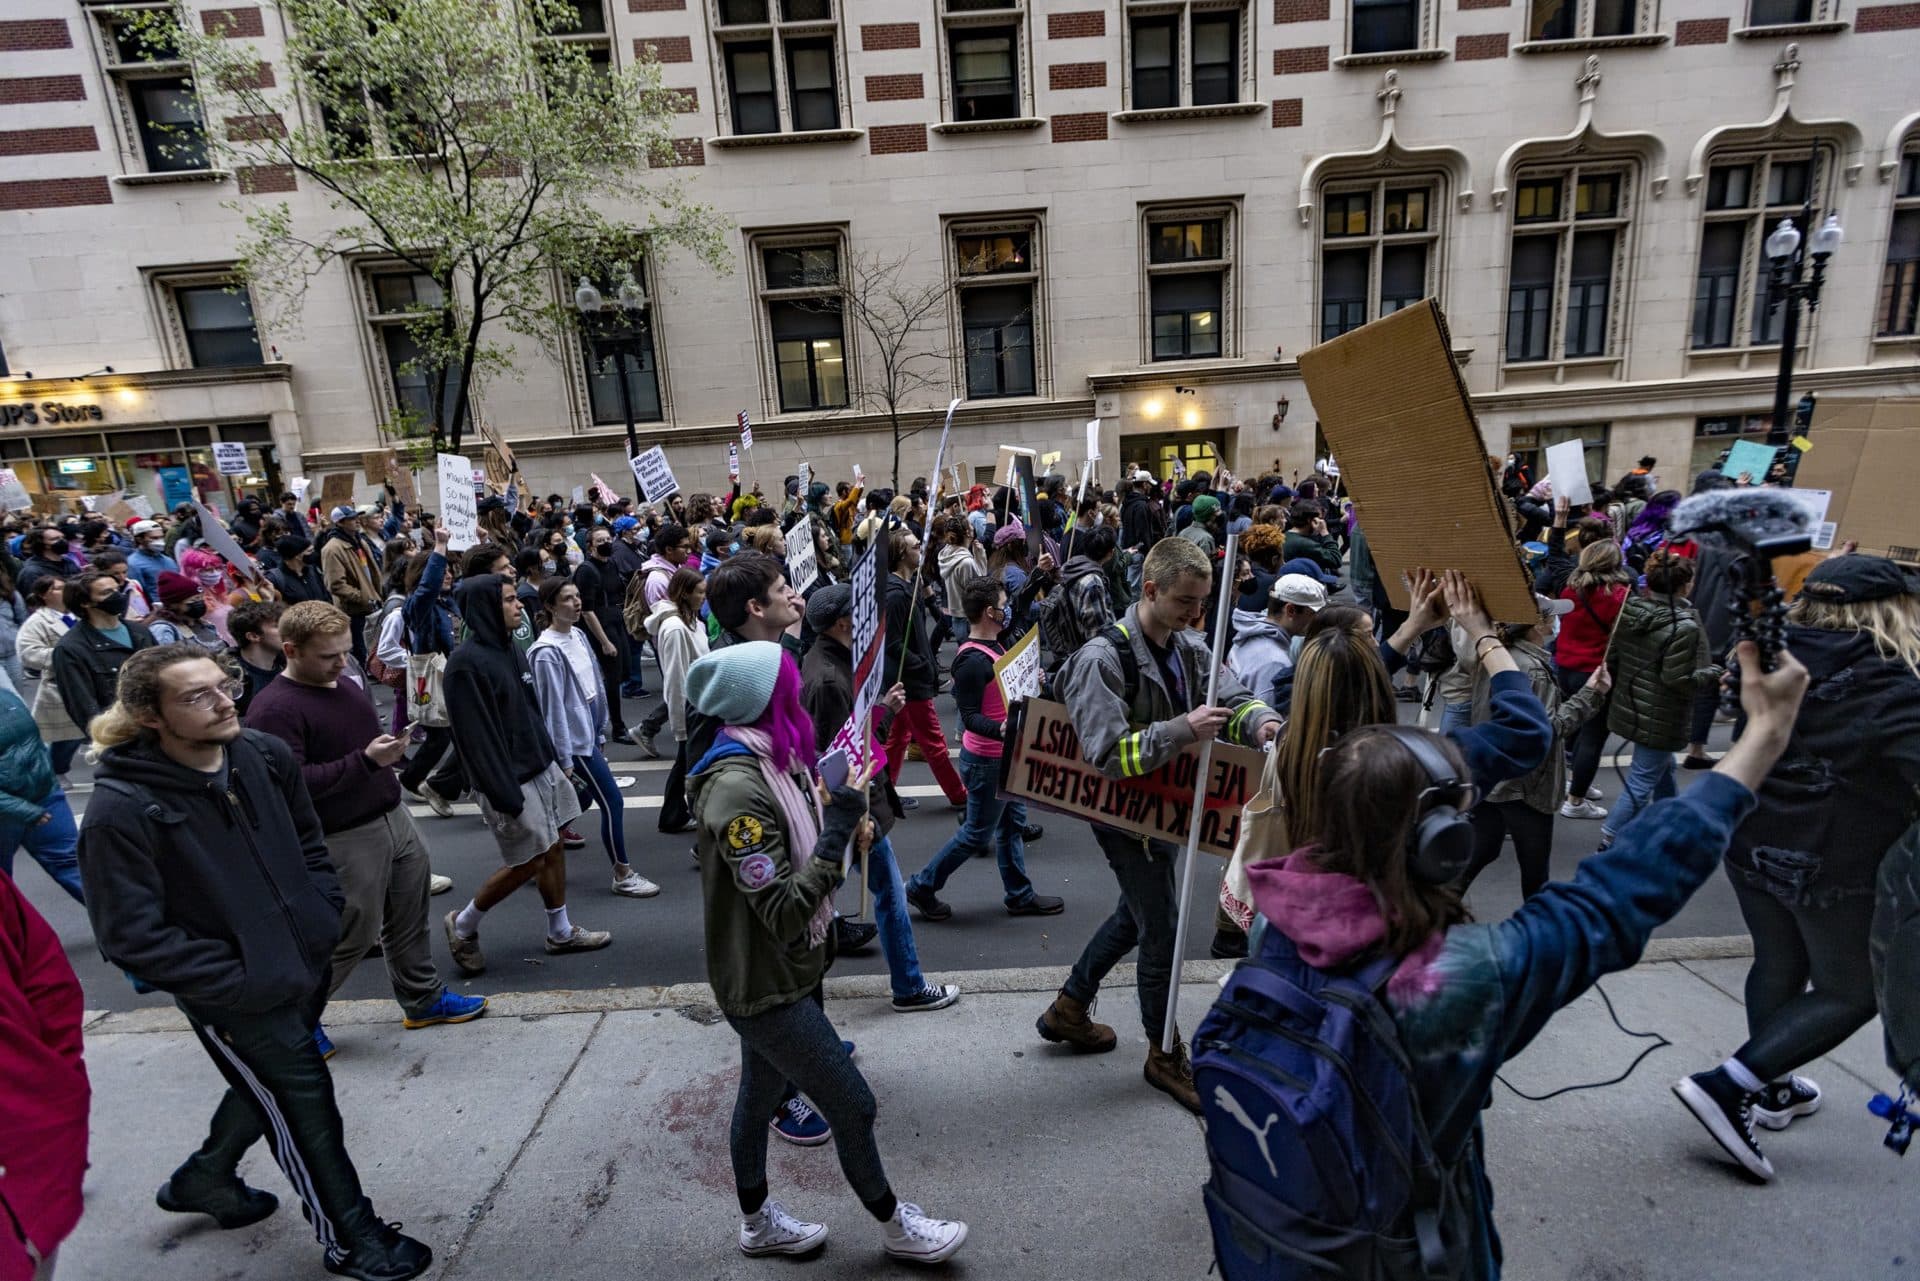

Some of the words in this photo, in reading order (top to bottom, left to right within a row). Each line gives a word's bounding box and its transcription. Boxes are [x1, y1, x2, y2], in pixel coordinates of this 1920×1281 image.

[42, 402, 103, 423] Store
[634, 452, 653, 466] Abolish
[641, 467, 659, 479] Enemy
[647, 485, 660, 497] Fight
[852, 543, 876, 607] FREE
[852, 576, 876, 640] SAFE
[852, 601, 879, 672] LEGAL
[1025, 757, 1082, 804] LEGAL
[1081, 775, 1105, 810] IS
[1208, 760, 1247, 805] WE
[1100, 780, 1164, 830] WHAT
[1167, 801, 1240, 850] FUK
